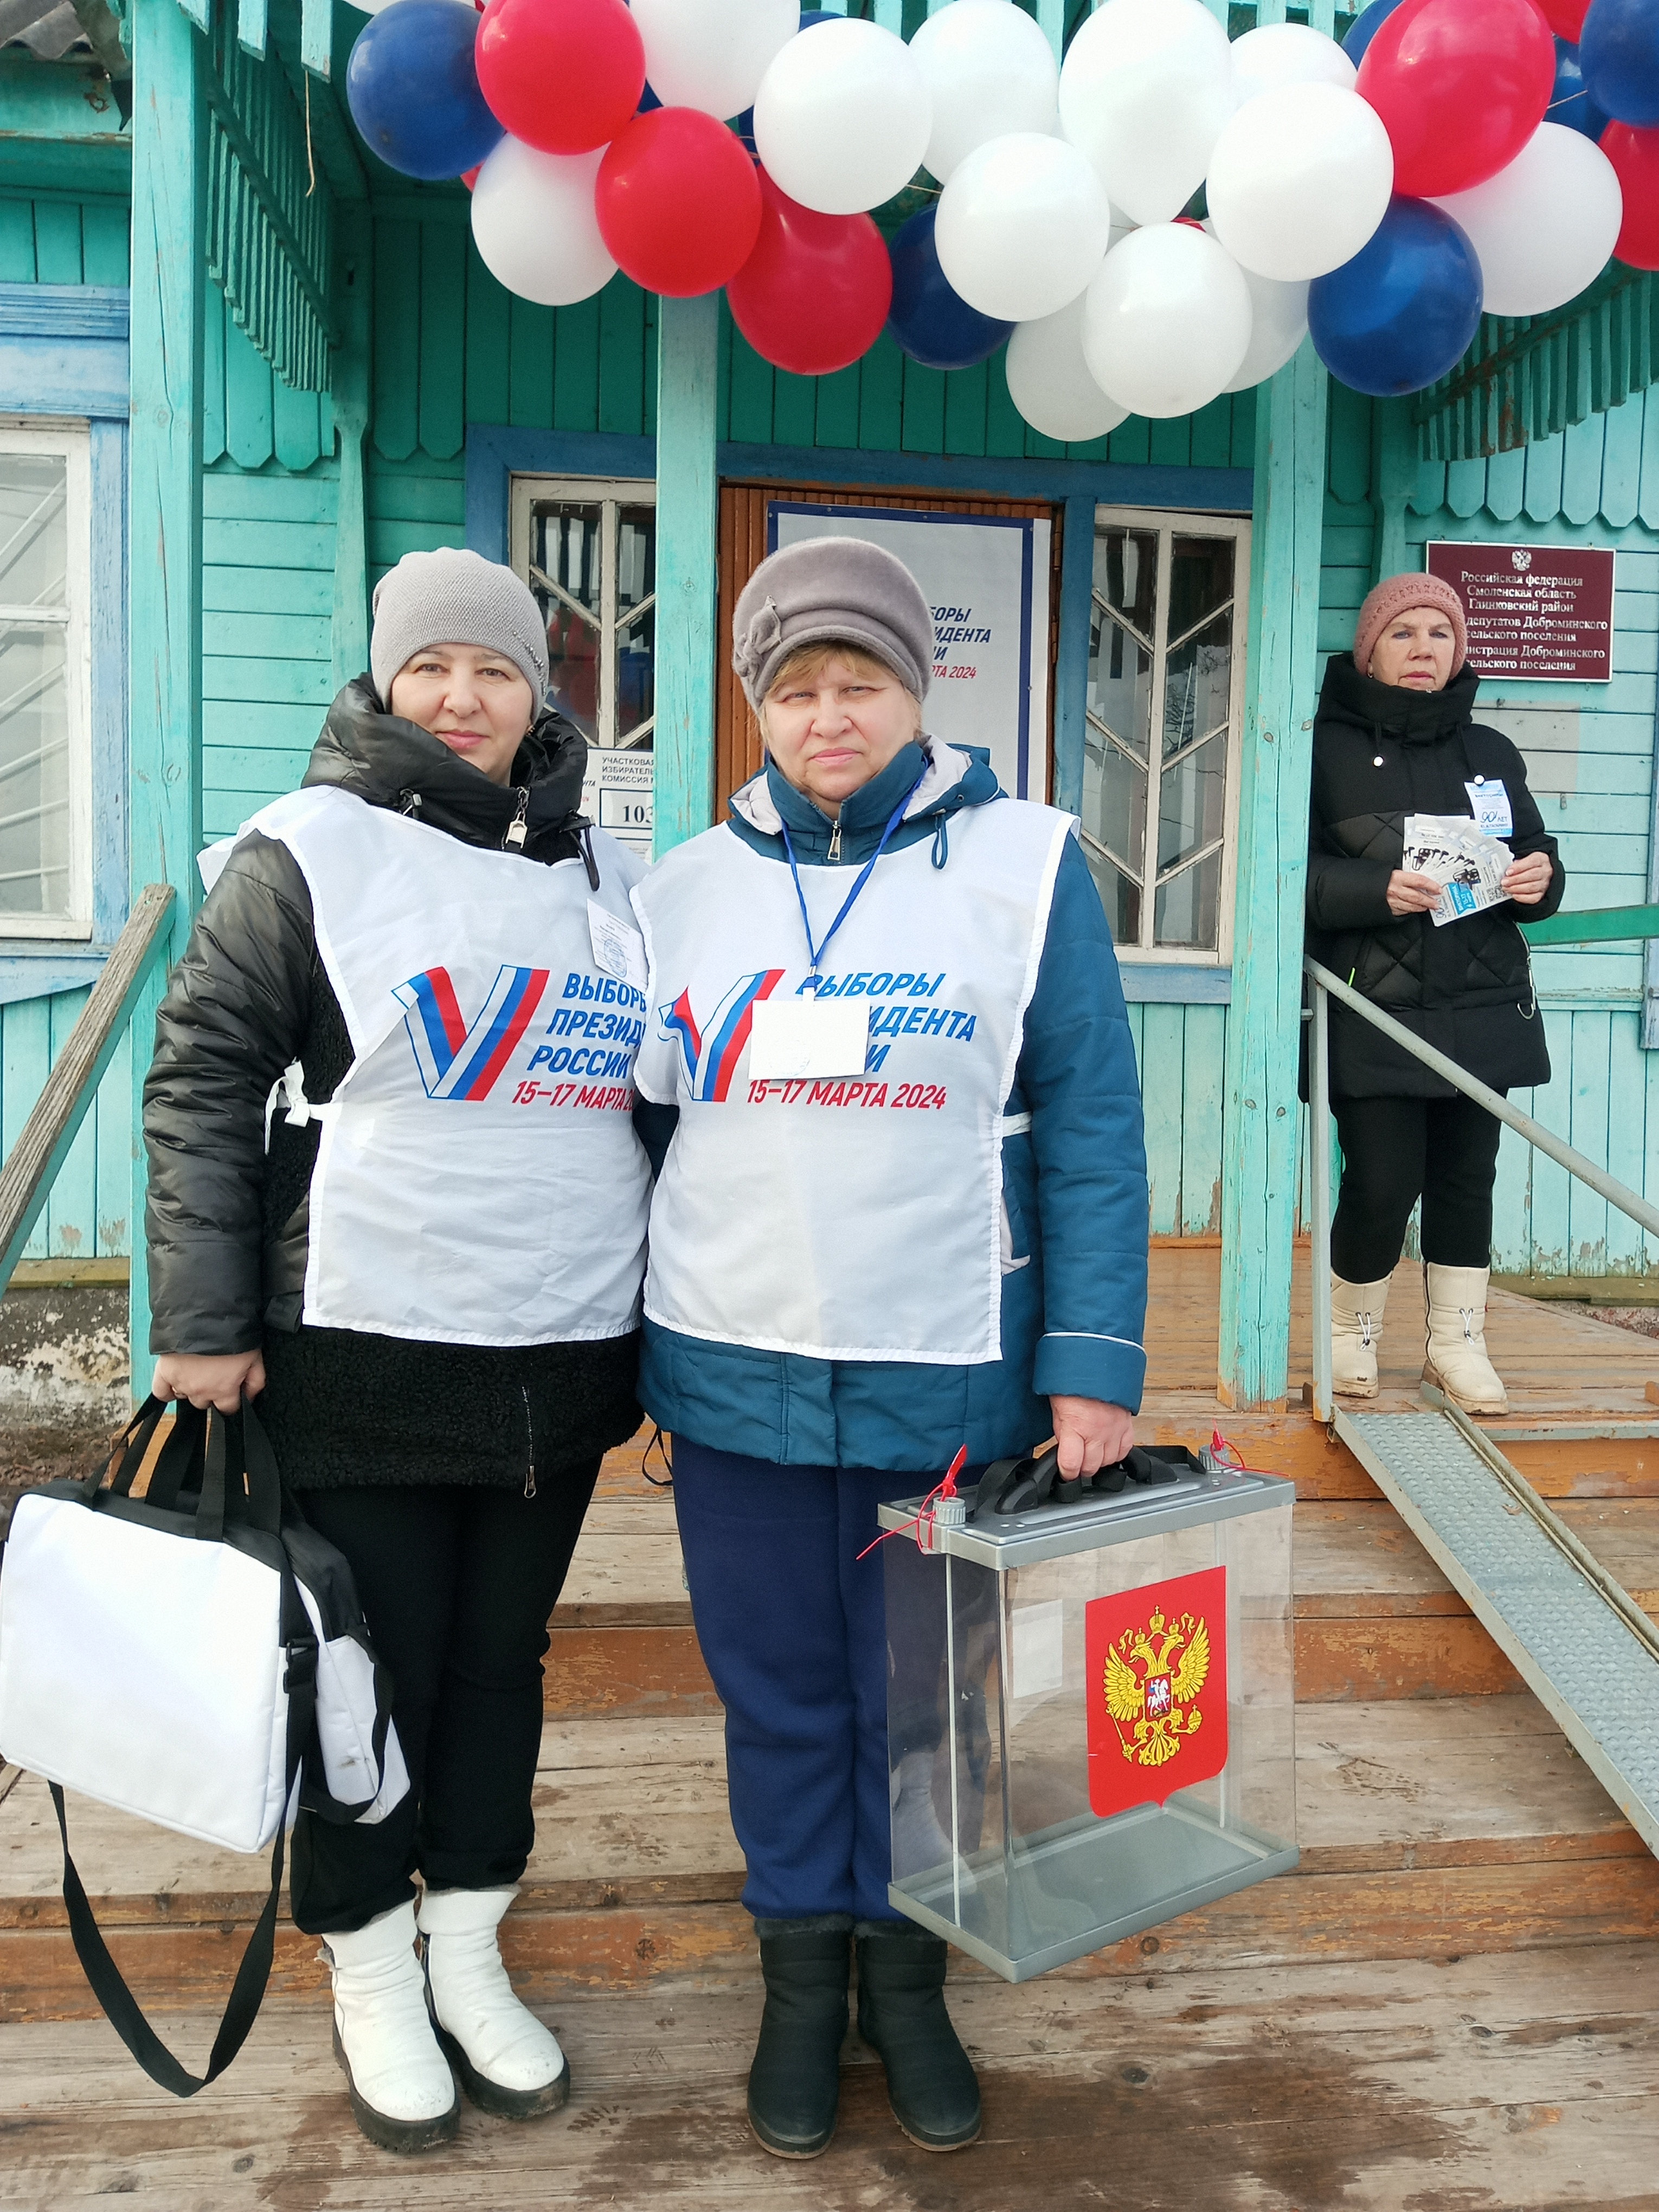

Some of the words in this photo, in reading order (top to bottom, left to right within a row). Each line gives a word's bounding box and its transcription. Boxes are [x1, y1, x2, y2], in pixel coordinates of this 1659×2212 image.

[1461, 571, 1523, 584] Российская
[1526, 574, 1583, 588] федерация
[1467, 585, 1532, 597] Смоленская
[1534, 588, 1577, 599] область
[1469, 598, 1538, 611] Глинковский
[1541, 601, 1574, 614] район
[1466, 617, 1521, 628] депутатов
[1523, 616, 1608, 630] Доброминского
[935, 626, 991, 643] ИДЕНТА
[1520, 632, 1577, 641] поселения
[1521, 645, 1605, 659] Доброминского
[1466, 659, 1517, 669] ельского
[1520, 660, 1576, 670] поселения
[949, 666, 977, 679] 2024
[602, 766, 653, 775] ИЗБИРАТЕЛЬ
[602, 775, 648, 783] КОМИССИЯ
[546, 1008, 646, 1049] ПРЕЗИД
[869, 1006, 976, 1042] ИДЕНТА
[526, 1045, 632, 1079] РОССИИ
[573, 1085, 627, 1110] МАРТА
[806, 1081, 889, 1108] МАРТА
[890, 1083, 947, 1110] 2024
